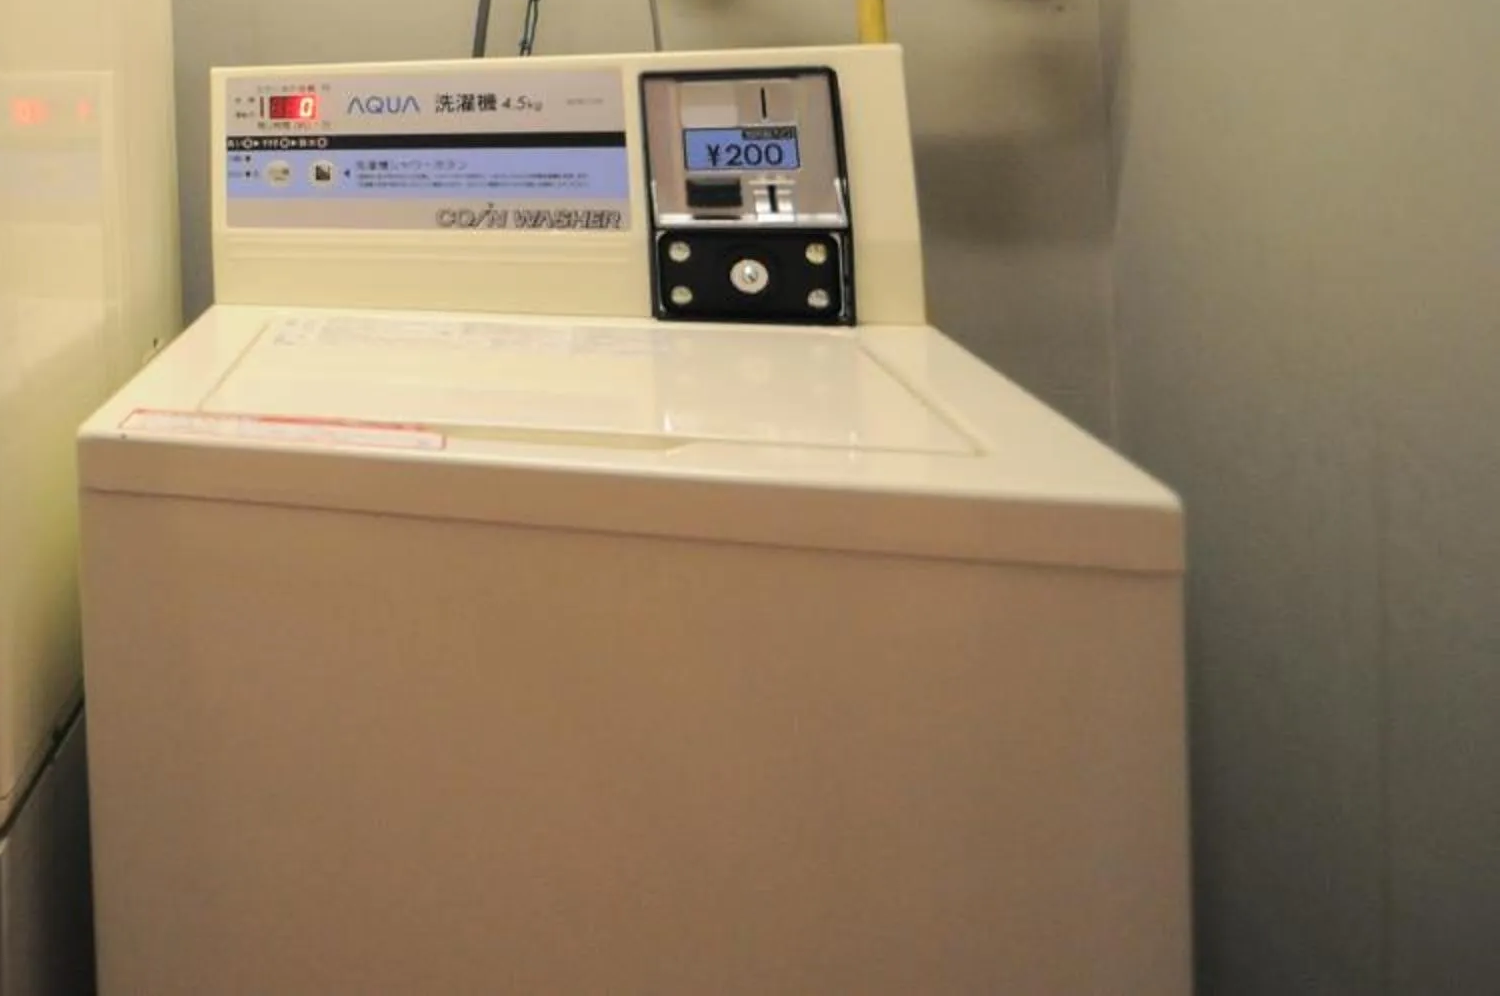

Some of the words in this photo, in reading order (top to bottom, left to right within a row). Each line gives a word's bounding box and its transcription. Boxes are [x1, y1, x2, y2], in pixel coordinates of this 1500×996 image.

[346, 95, 422, 115] AQUA
[435, 92, 498, 114] 洗濯機
[706, 142, 784, 167] ¥200
[513, 207, 622, 230] WASHER
